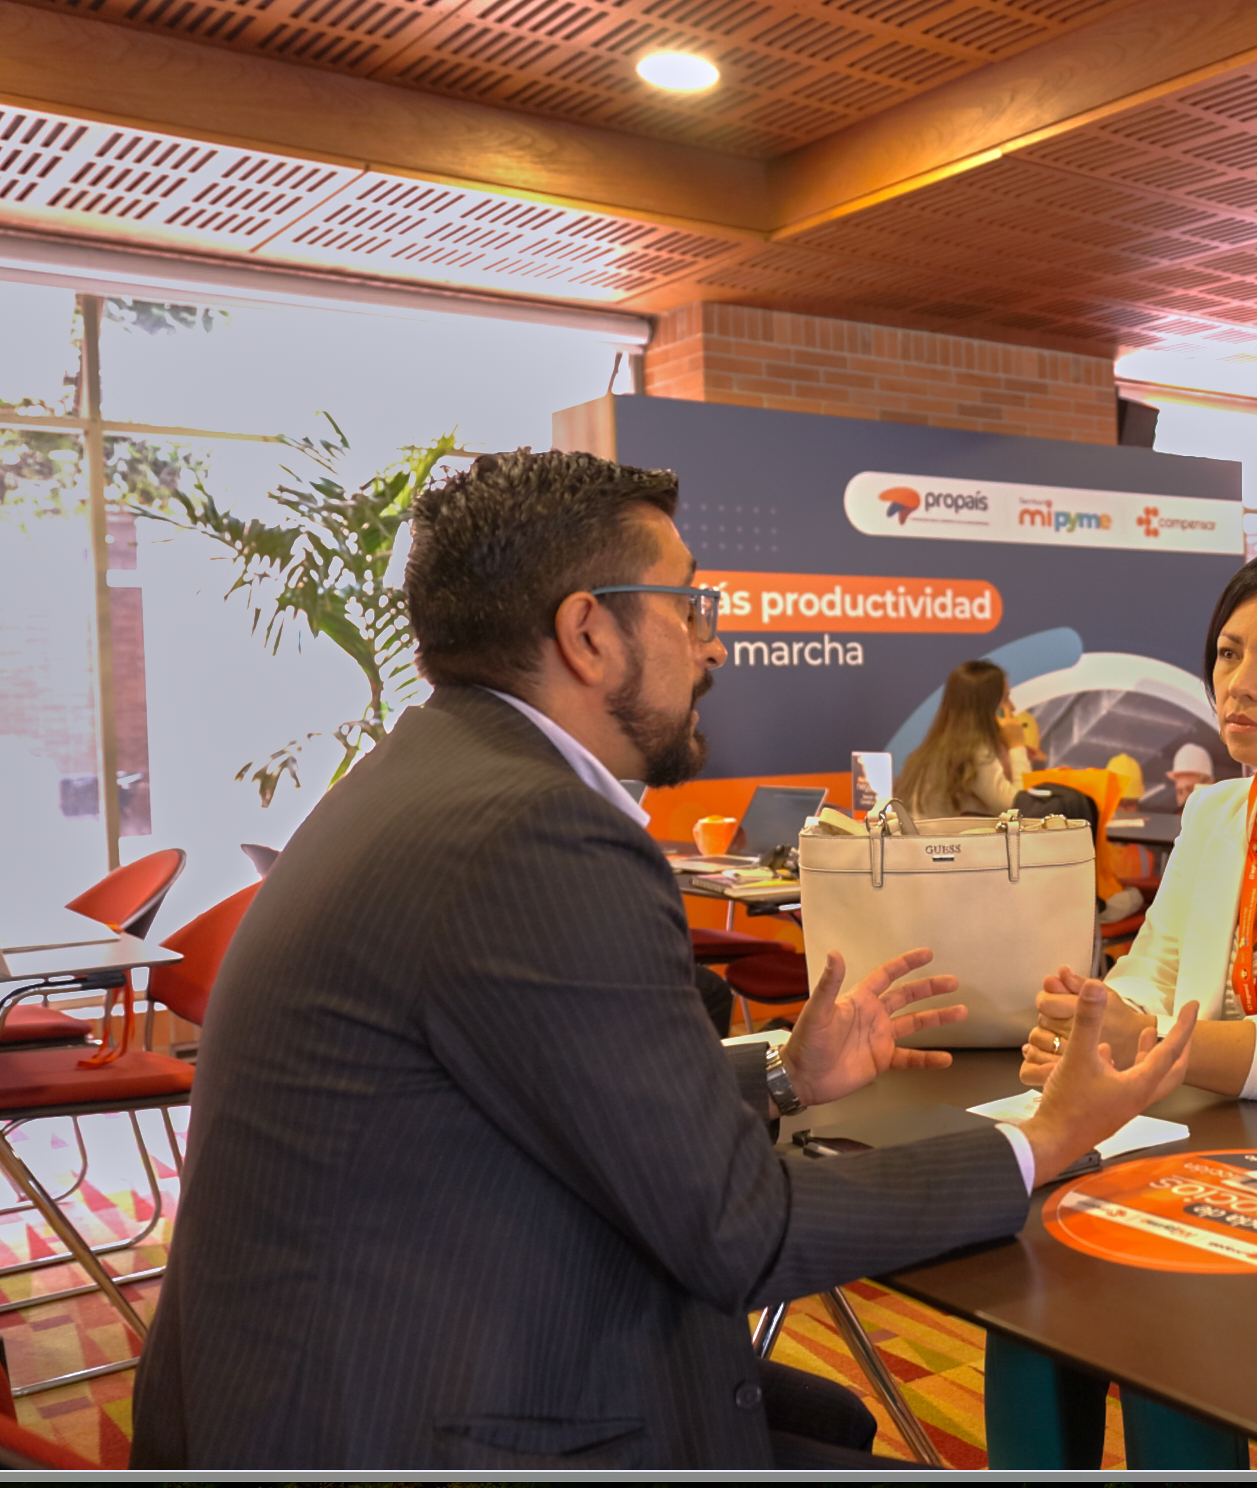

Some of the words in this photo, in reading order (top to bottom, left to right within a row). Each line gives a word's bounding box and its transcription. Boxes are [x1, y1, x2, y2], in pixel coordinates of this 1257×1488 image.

[924, 490, 989, 514] propaís
[762, 585, 992, 623] productividad
[733, 633, 864, 666] marcha
[925, 843, 961, 855] GUESS
[1193, 1203, 1227, 1218] de
